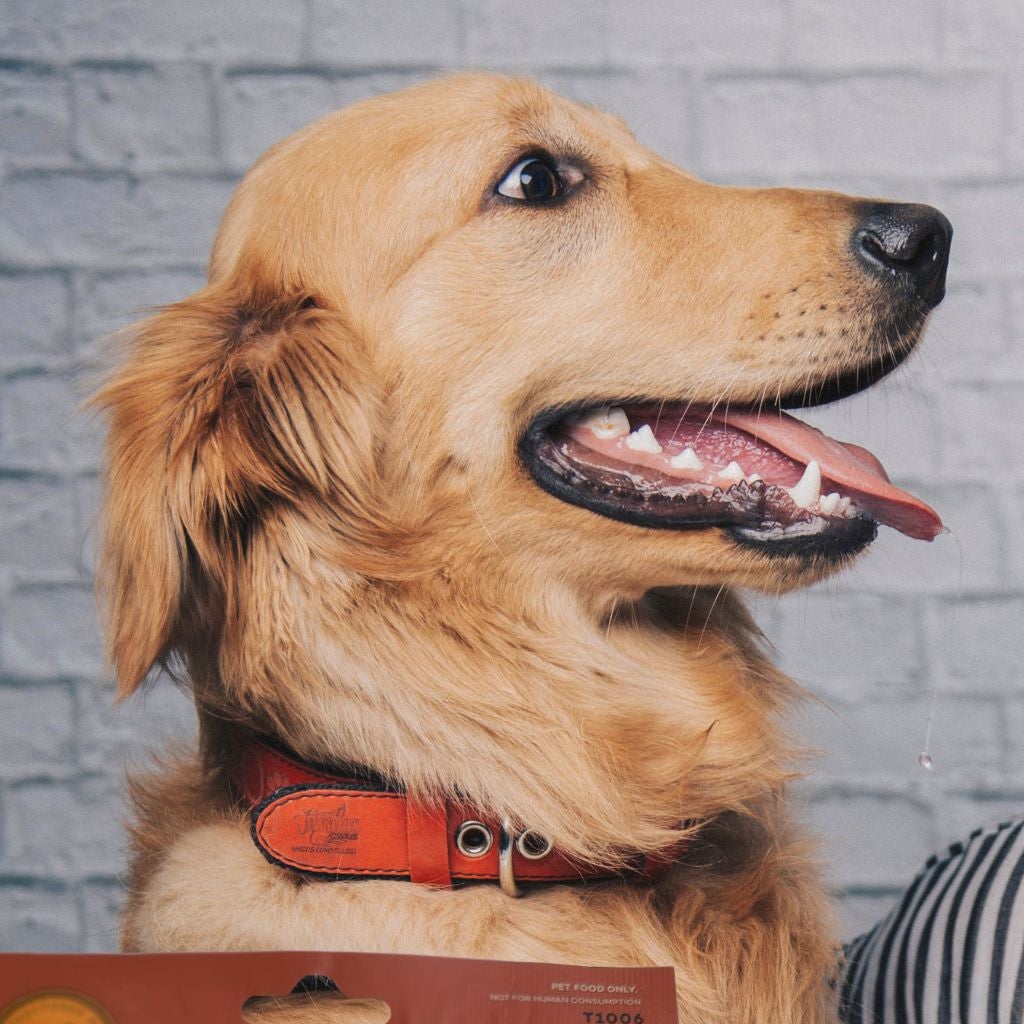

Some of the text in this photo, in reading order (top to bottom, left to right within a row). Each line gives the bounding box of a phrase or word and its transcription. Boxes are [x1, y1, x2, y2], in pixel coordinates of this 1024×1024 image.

[551, 982, 571, 991] PET
[573, 984, 604, 993] FOOD
[490, 993, 641, 1006] NOT FOR HUMAN CONSUMPTION
[583, 1012, 645, 1024] T1006
